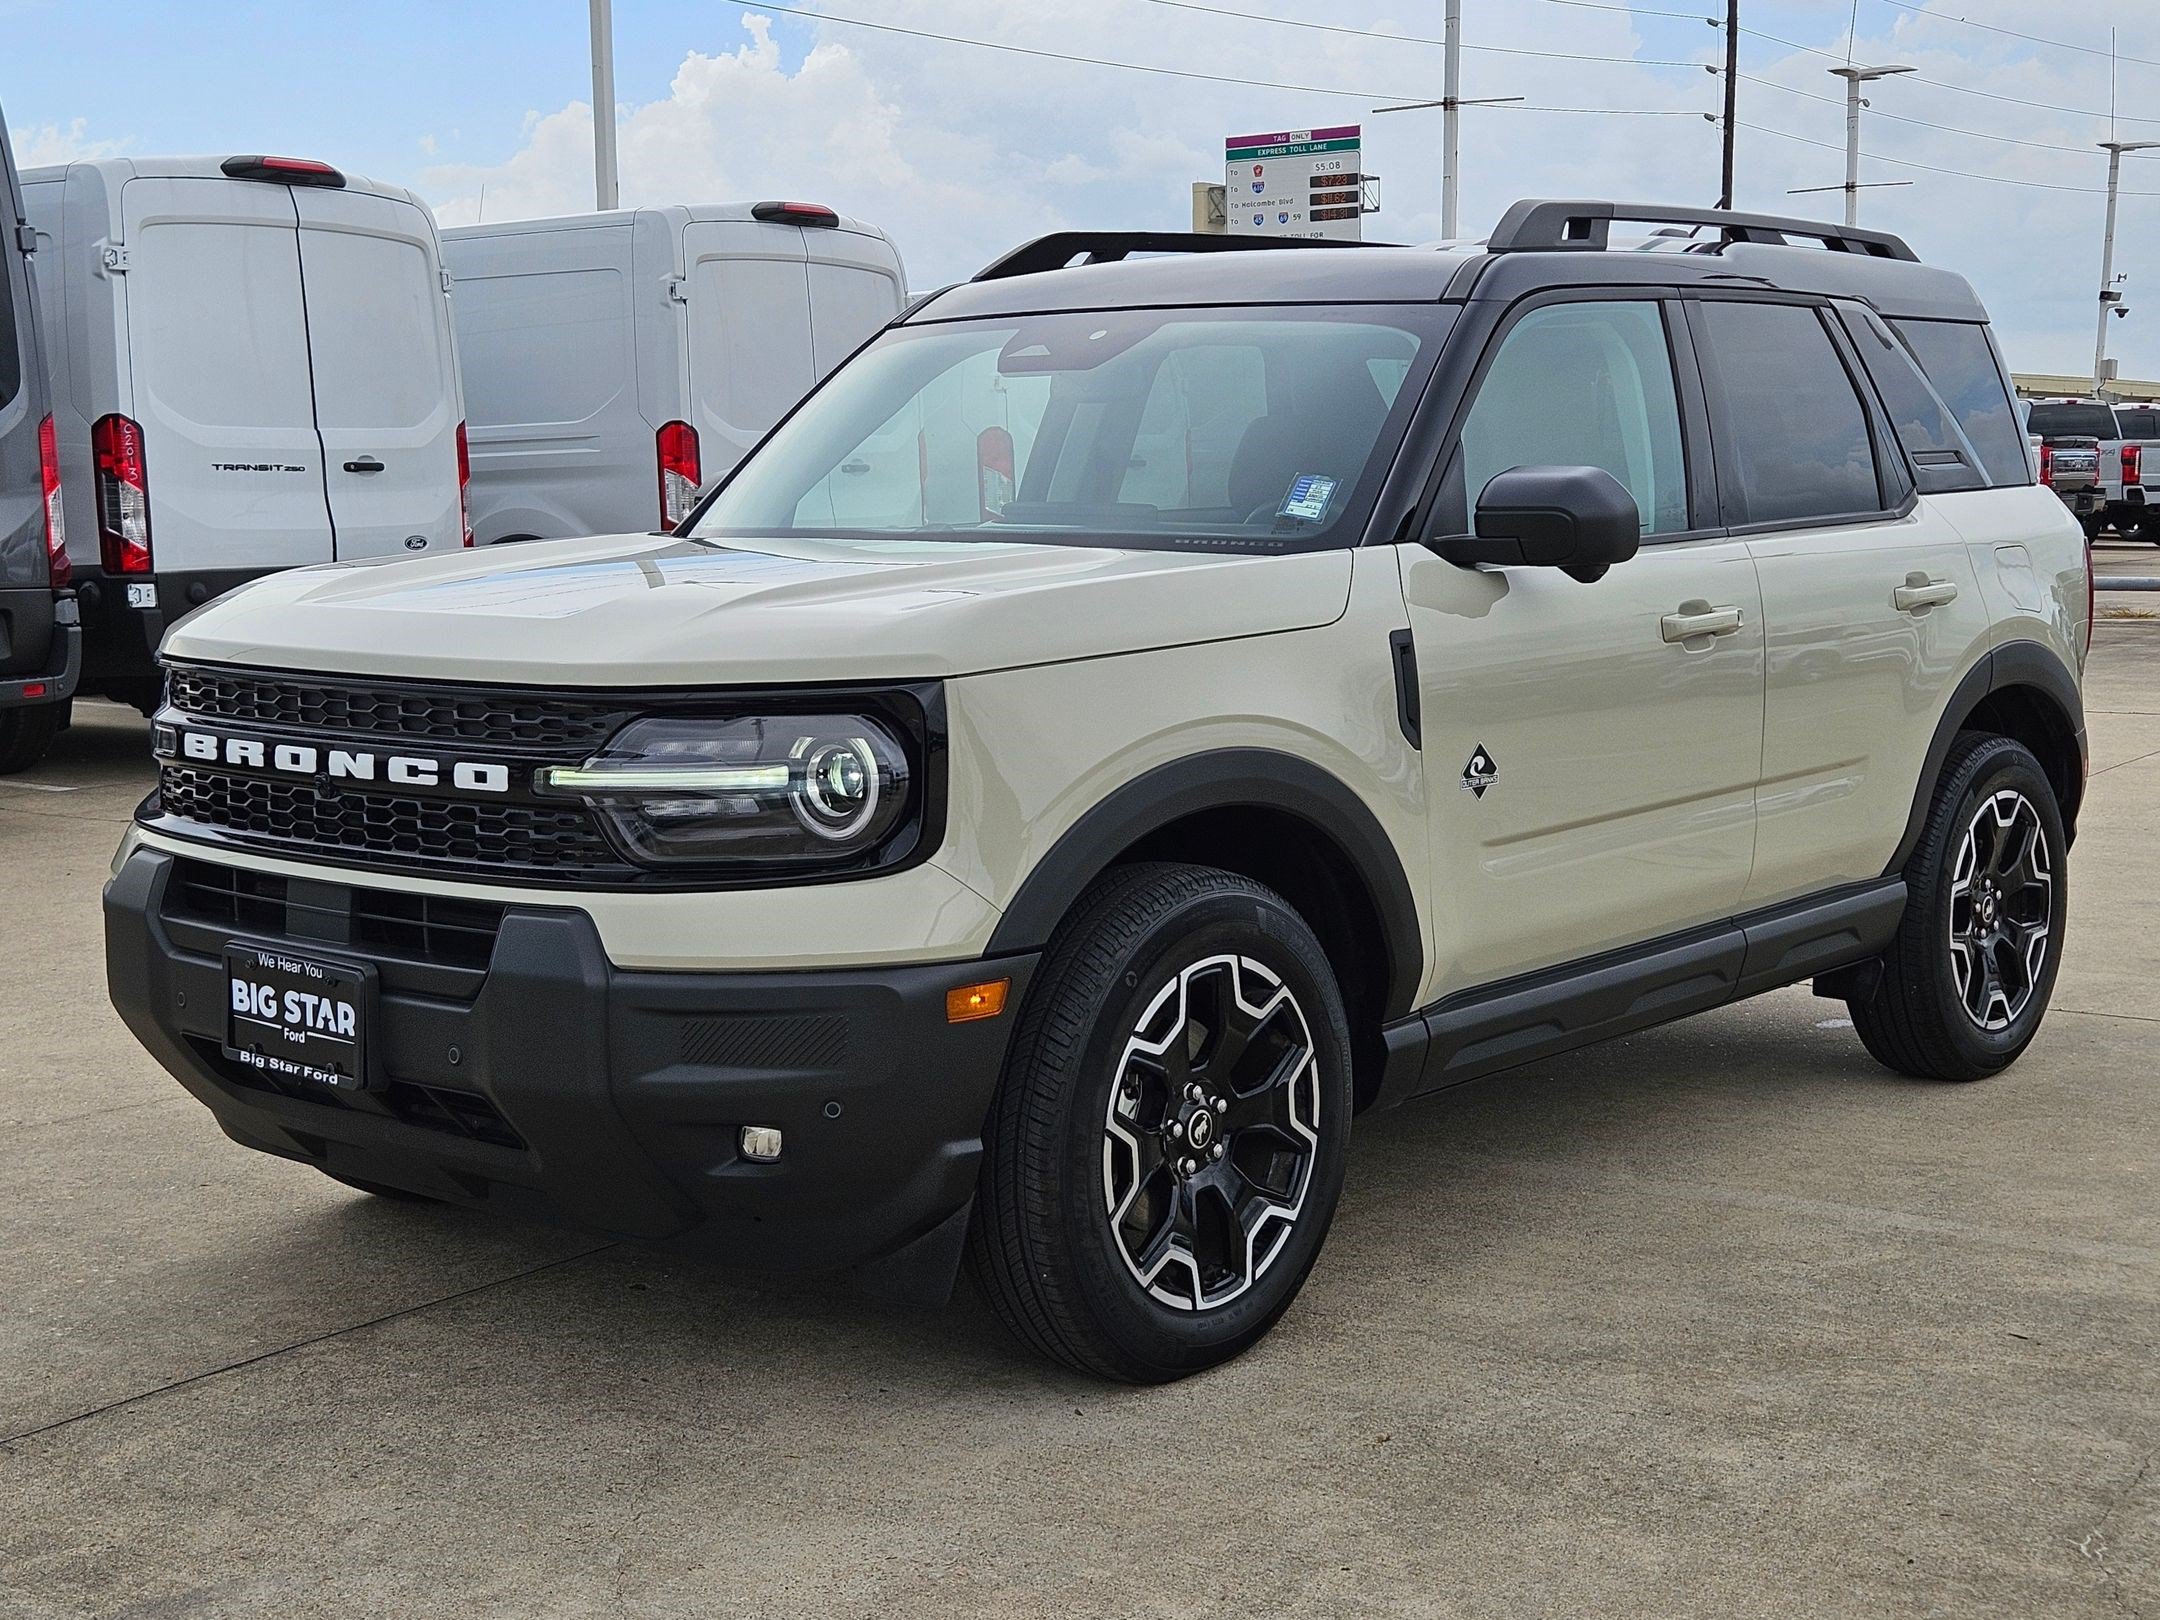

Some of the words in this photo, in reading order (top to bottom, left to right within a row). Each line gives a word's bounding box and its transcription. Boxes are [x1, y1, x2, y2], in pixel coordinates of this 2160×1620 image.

[1291, 132, 1310, 140] ONLY
[1257, 147, 1287, 155] EXPRESS
[1290, 145, 1307, 153] TOLL
[1309, 143, 1328, 151] LANE
[1315, 161, 1341, 172] $5.08
[1241, 200, 1276, 208] Holcombe
[211, 463, 284, 471] TRANSIT
[184, 732, 509, 792] BRONCO
[258, 953, 274, 968] We
[277, 957, 302, 974] Hear
[304, 962, 323, 979] You
[231, 978, 278, 1018] BIG
[284, 990, 356, 1037] STAR
[284, 1027, 305, 1043] Ford
[240, 1050, 265, 1068] Big
[269, 1058, 300, 1075] Star
[303, 1066, 339, 1085] Ford
